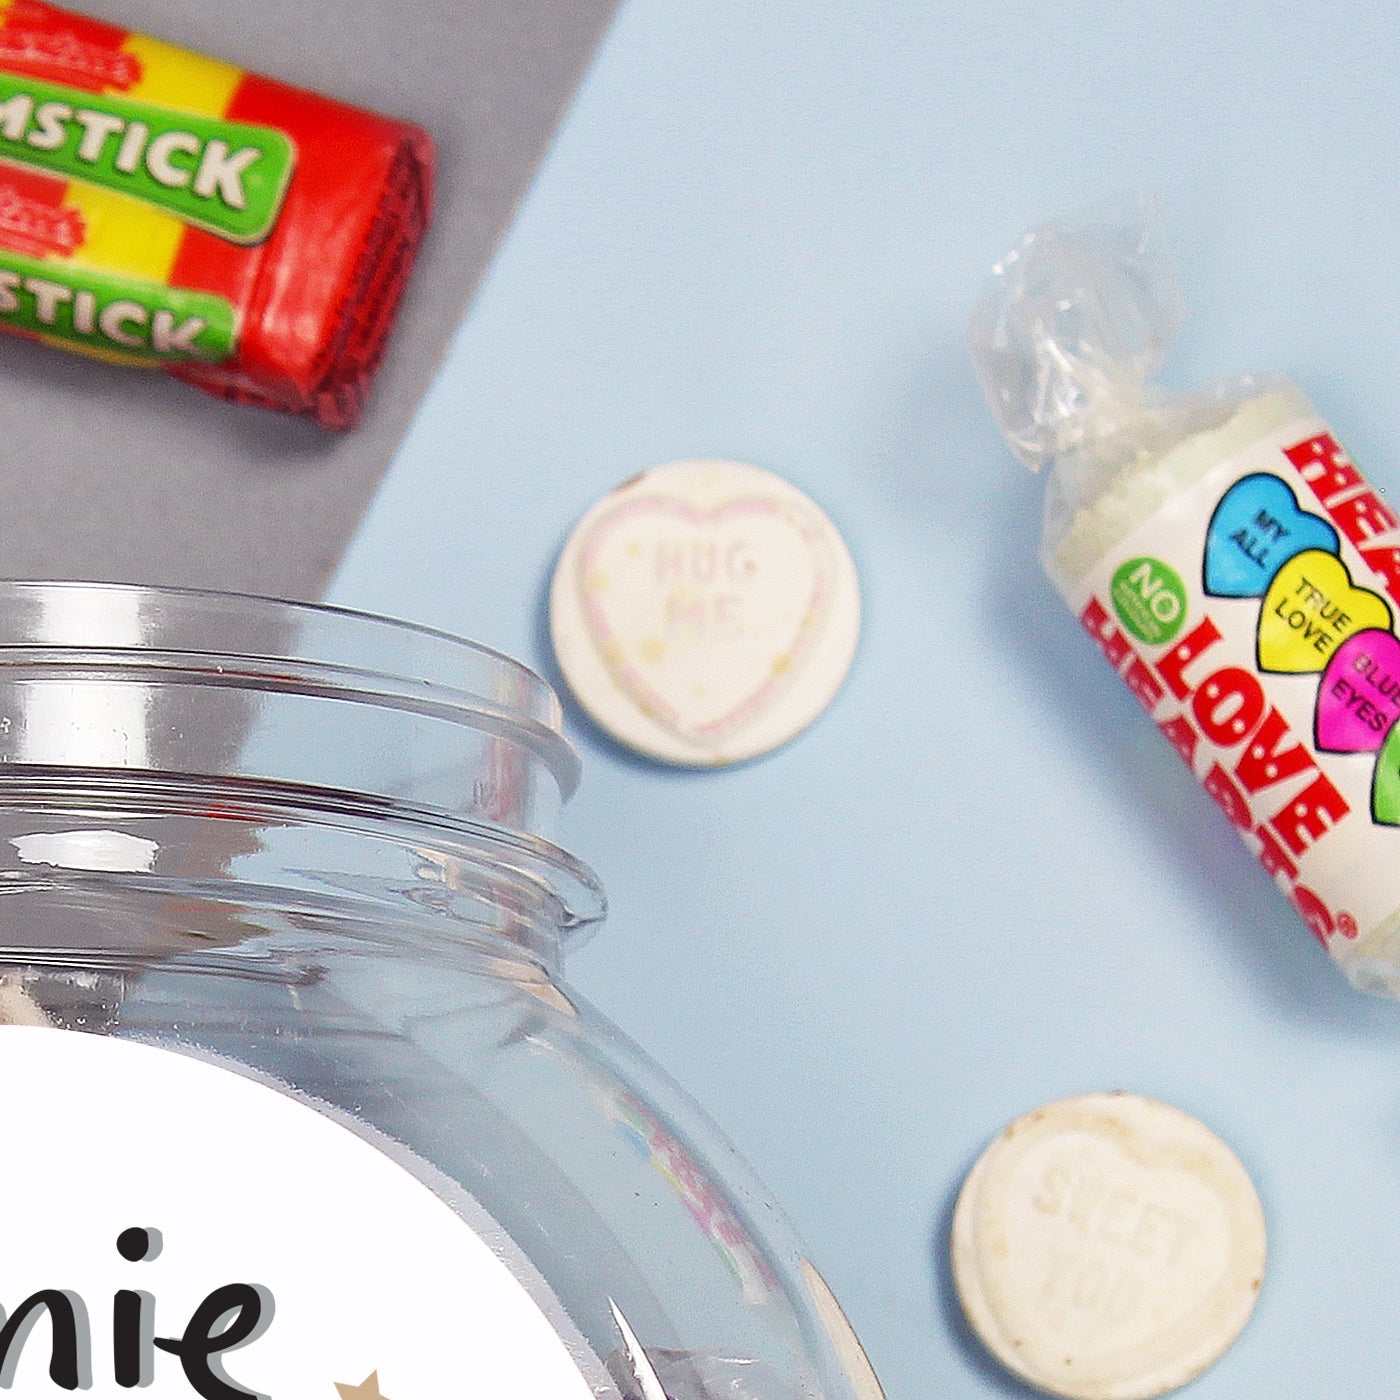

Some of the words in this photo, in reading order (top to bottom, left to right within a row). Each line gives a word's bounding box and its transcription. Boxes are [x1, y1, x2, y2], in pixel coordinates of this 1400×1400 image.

[1229, 528, 1271, 571] ALL
[1128, 562, 1181, 622] NO
[1295, 576, 1353, 633] TRUE
[1274, 597, 1334, 654] LOVE
[1330, 678, 1389, 732] EYES
[1153, 614, 1352, 857] LOVE
